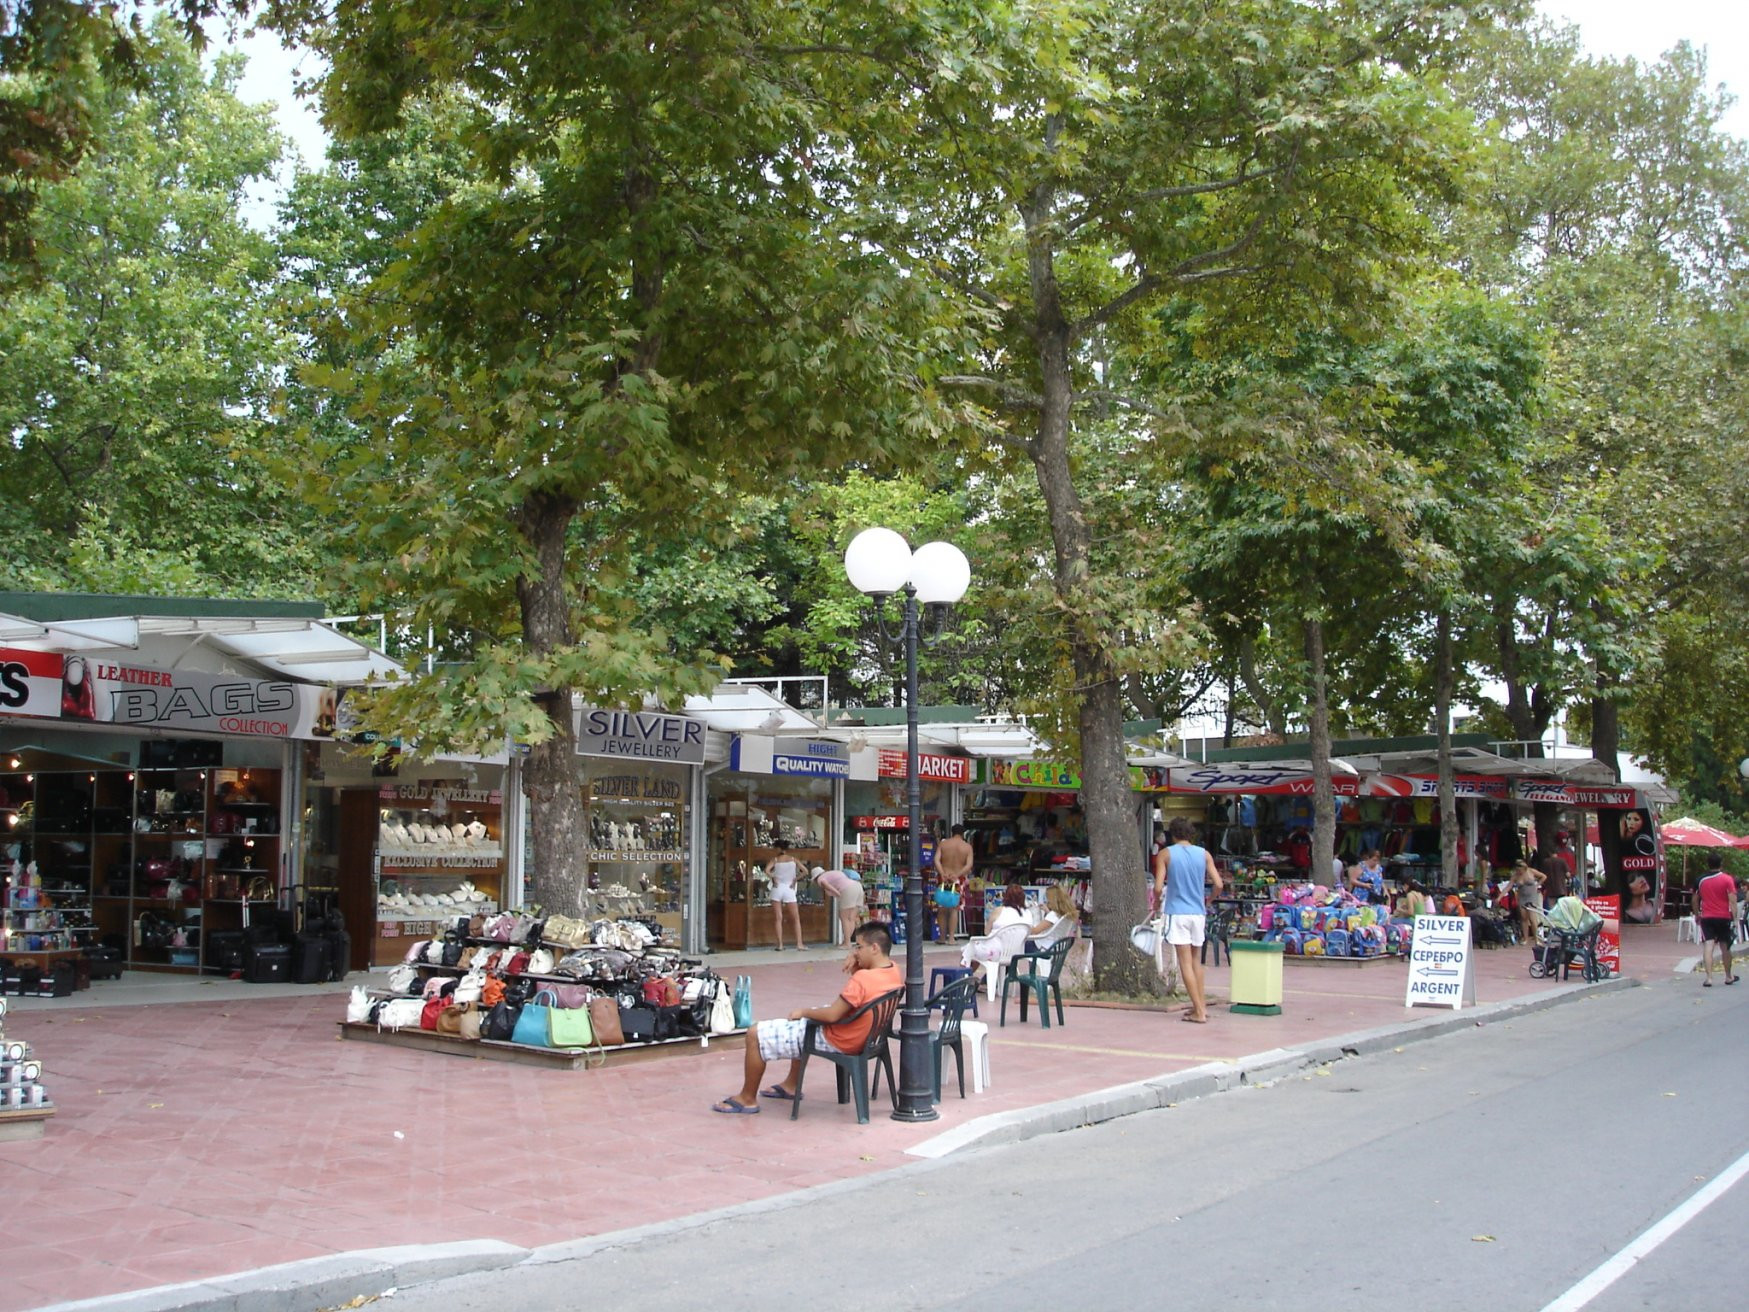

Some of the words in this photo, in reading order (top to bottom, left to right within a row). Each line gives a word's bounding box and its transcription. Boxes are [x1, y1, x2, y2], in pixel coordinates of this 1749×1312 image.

[97, 664, 173, 687] LEATHER
[110, 681, 294, 724] BAGS
[219, 717, 289, 736] COLLECTION
[588, 710, 702, 745] SILVER
[600, 740, 681, 759] JEWELLERY
[808, 743, 838, 756] HIGHT
[776, 756, 823, 773] QUALITY
[917, 755, 965, 778] ARKET
[400, 786, 428, 800] GOLD
[593, 776, 640, 797] SILVER
[643, 777, 680, 799] LAND
[1289, 783, 1356, 794] WAR
[590, 852, 618, 861] CHIC
[621, 852, 681, 861] SELECTION
[1623, 858, 1655, 868] GOLD
[403, 921, 432, 936] HIGH
[1417, 918, 1465, 932] SILVER
[1412, 950, 1463, 963] СЕРЕБРО
[1410, 981, 1461, 995] ARGENT
